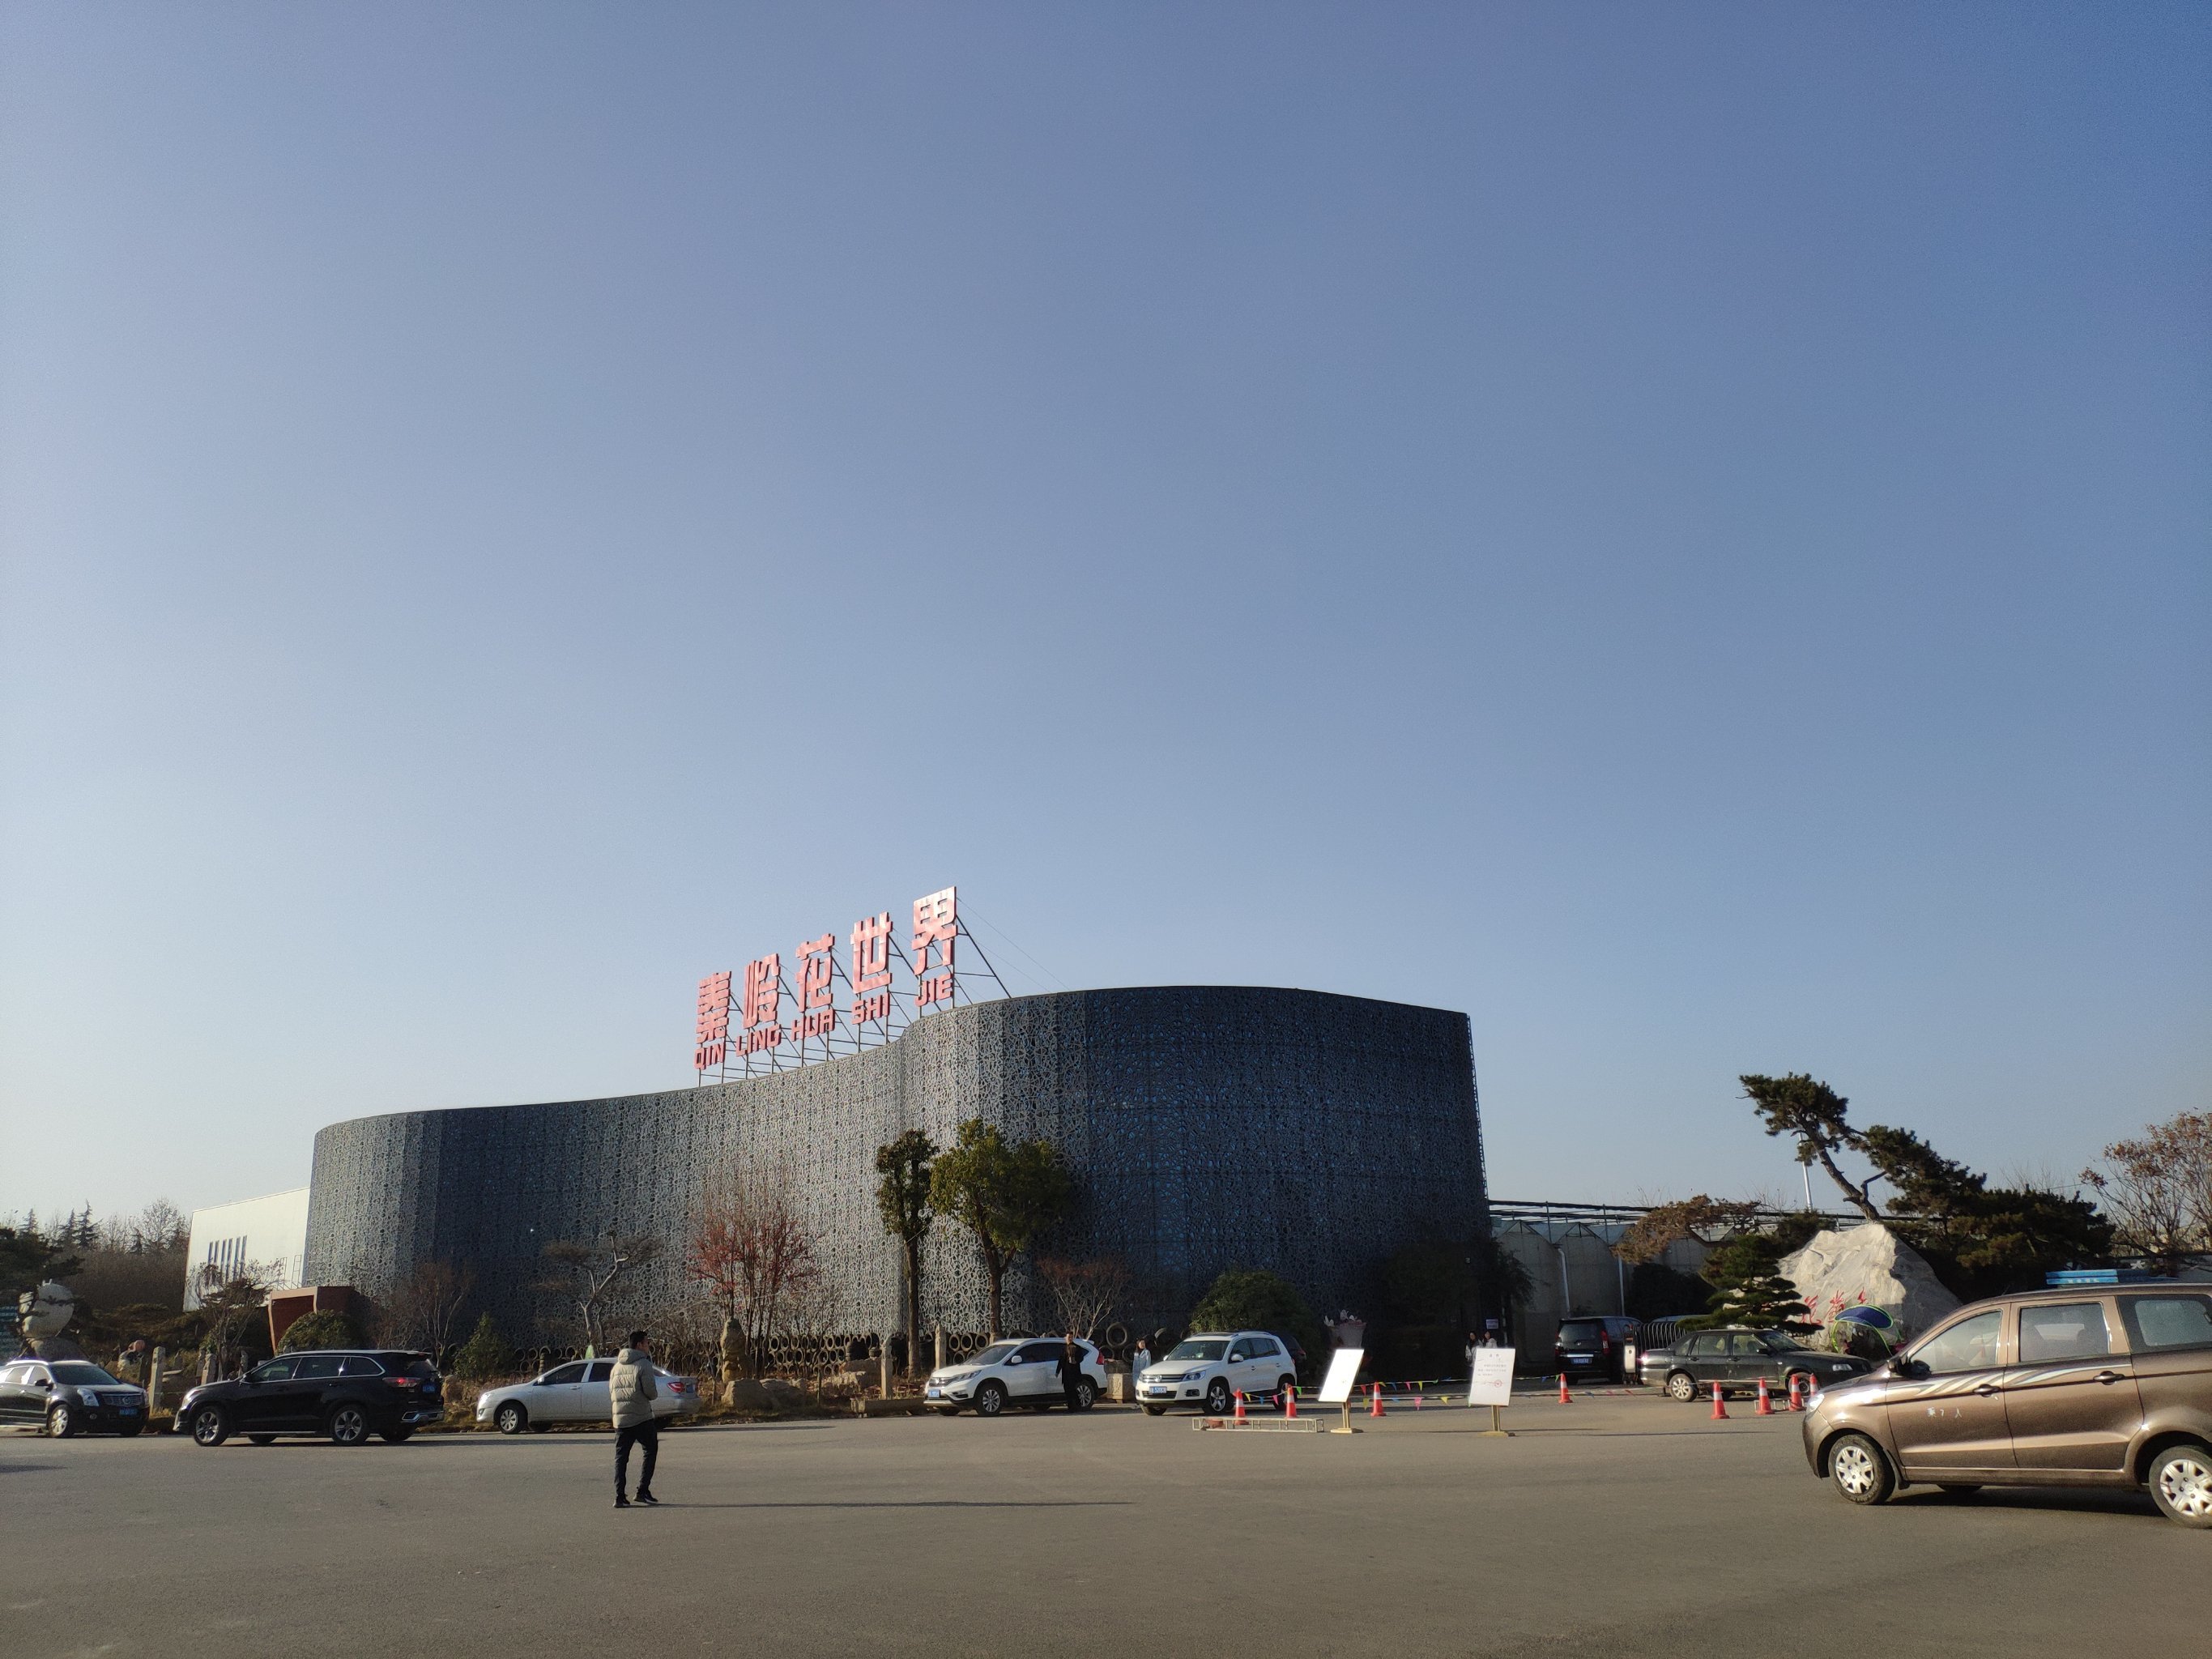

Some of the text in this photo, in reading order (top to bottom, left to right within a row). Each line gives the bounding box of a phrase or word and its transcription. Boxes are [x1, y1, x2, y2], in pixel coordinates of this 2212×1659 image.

[694, 971, 953, 1070] QIN LING HUA SHI JIE
[696, 886, 958, 1044] 秦岭花世界
